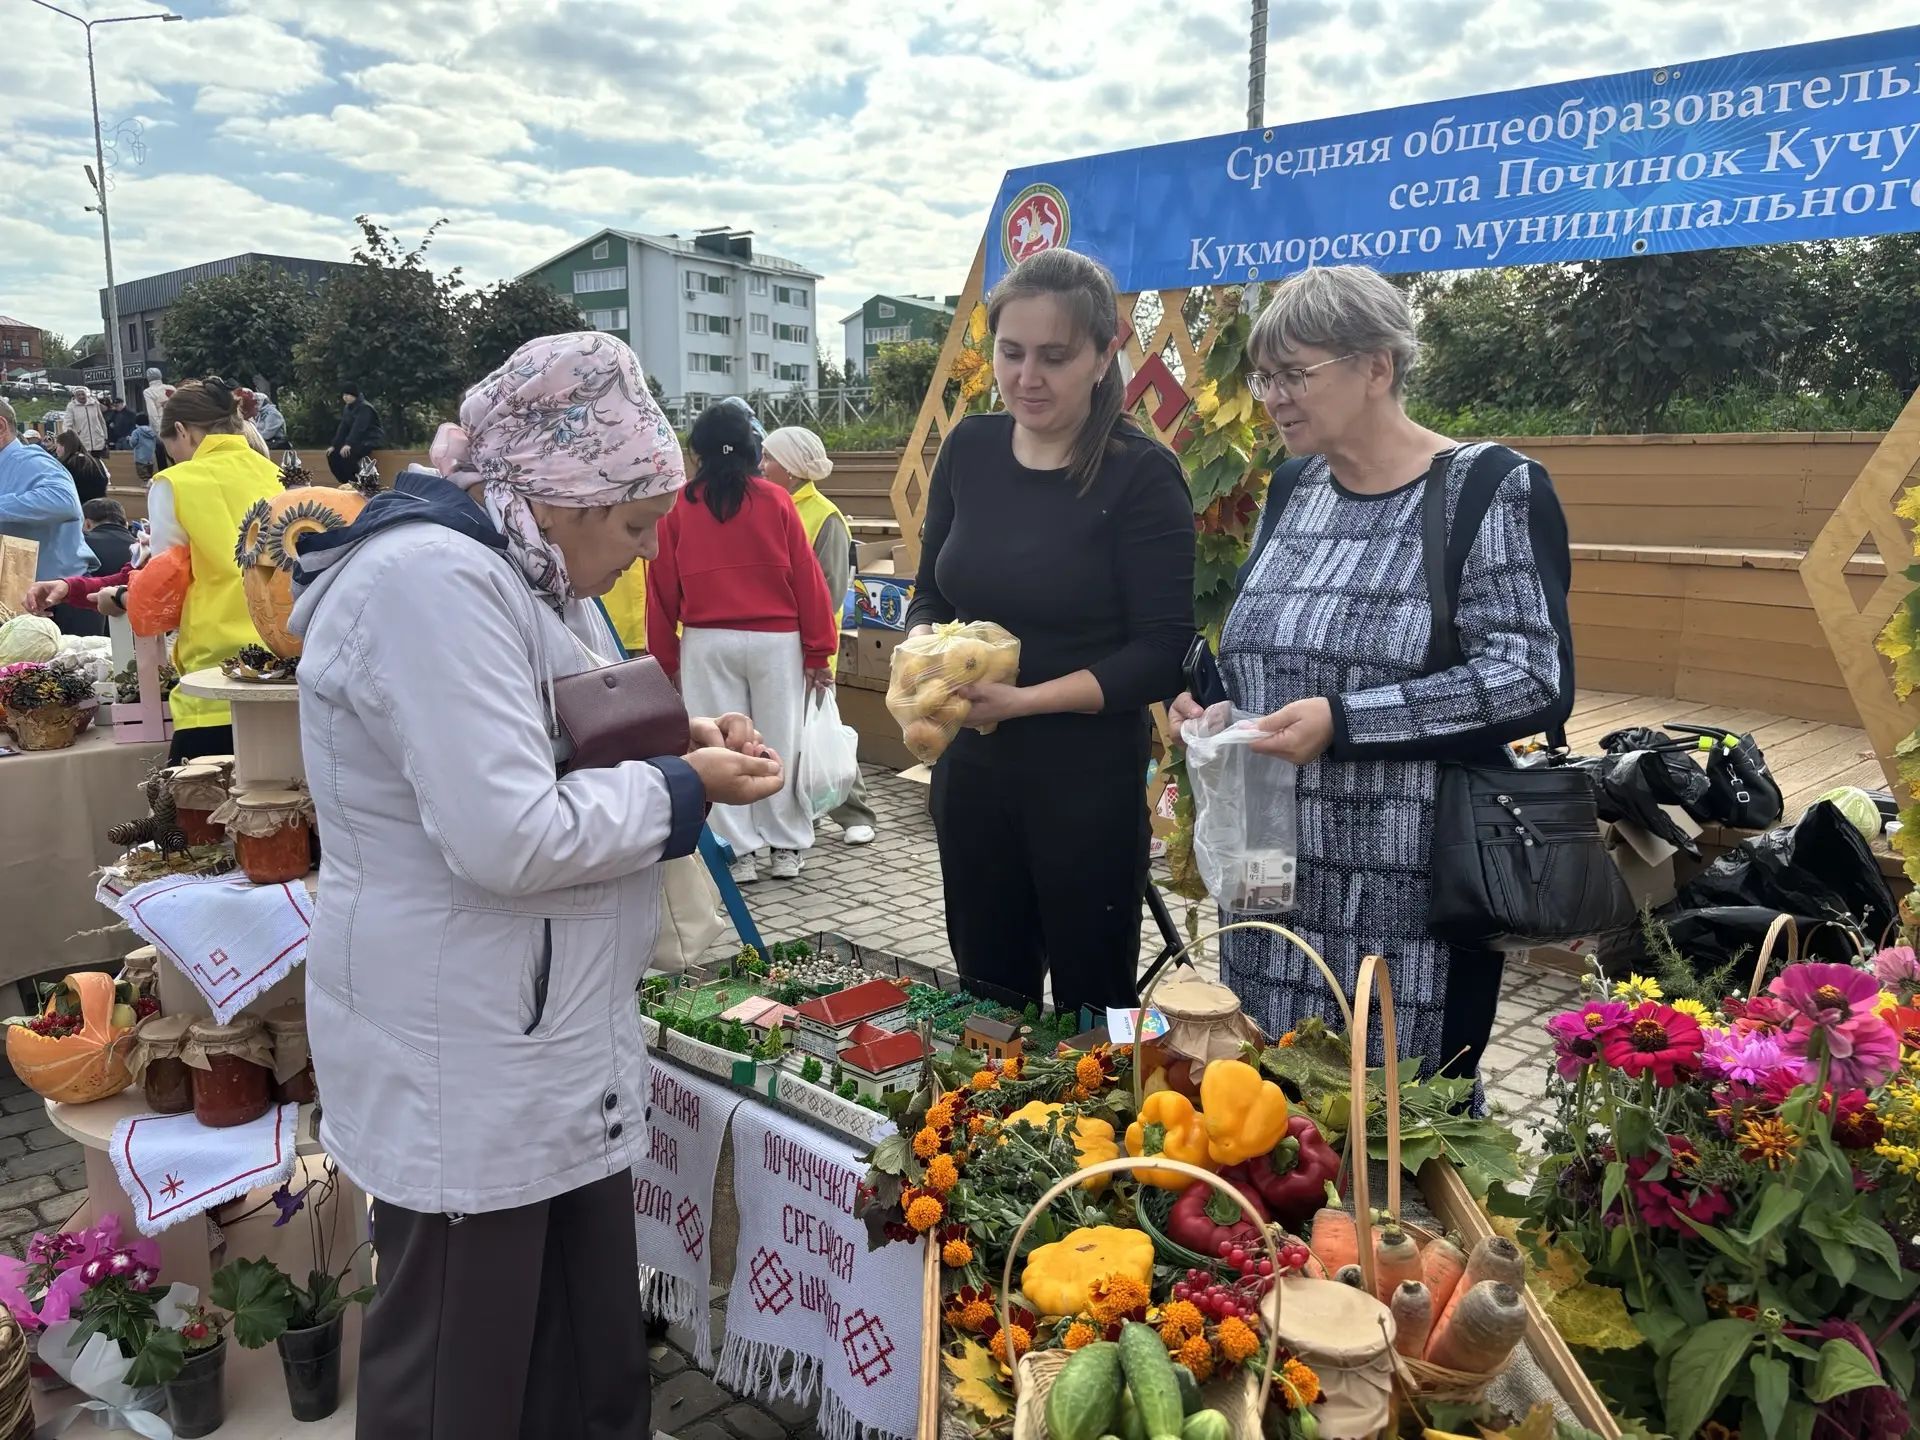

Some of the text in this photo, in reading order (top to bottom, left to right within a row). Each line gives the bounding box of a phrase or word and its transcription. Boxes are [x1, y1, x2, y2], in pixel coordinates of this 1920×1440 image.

[1226, 136, 1393, 190] Средняя
[1389, 122, 1920, 210] села Починок Кучу
[1188, 225, 1442, 280] Кукморского
[646, 1125, 678, 1175] НЯЯ
[633, 1178, 673, 1225] ОЛА
[798, 1270, 841, 1343] ШКЛА
